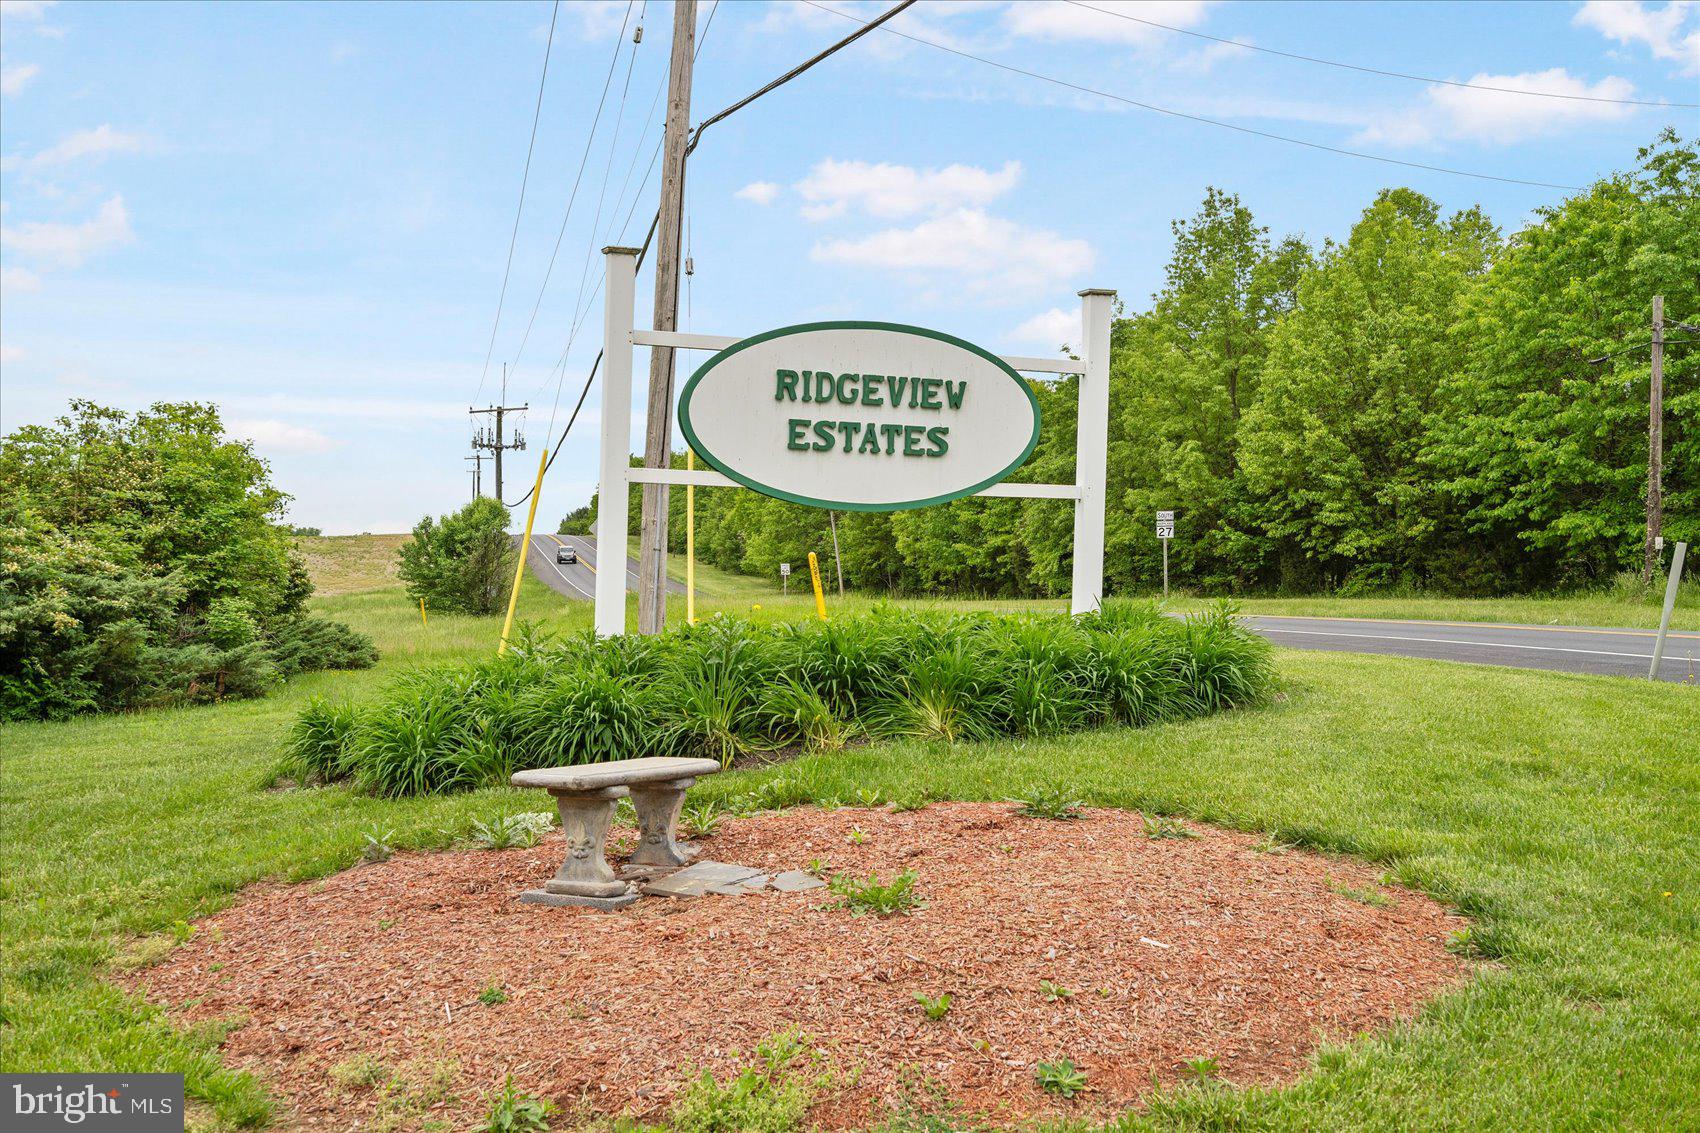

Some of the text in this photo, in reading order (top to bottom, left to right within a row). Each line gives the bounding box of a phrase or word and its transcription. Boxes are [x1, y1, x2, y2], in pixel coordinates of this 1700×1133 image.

[775, 369, 967, 409] RIDGEVIEW
[787, 419, 950, 457] ESTATES
[1158, 527, 1173, 537] 27
